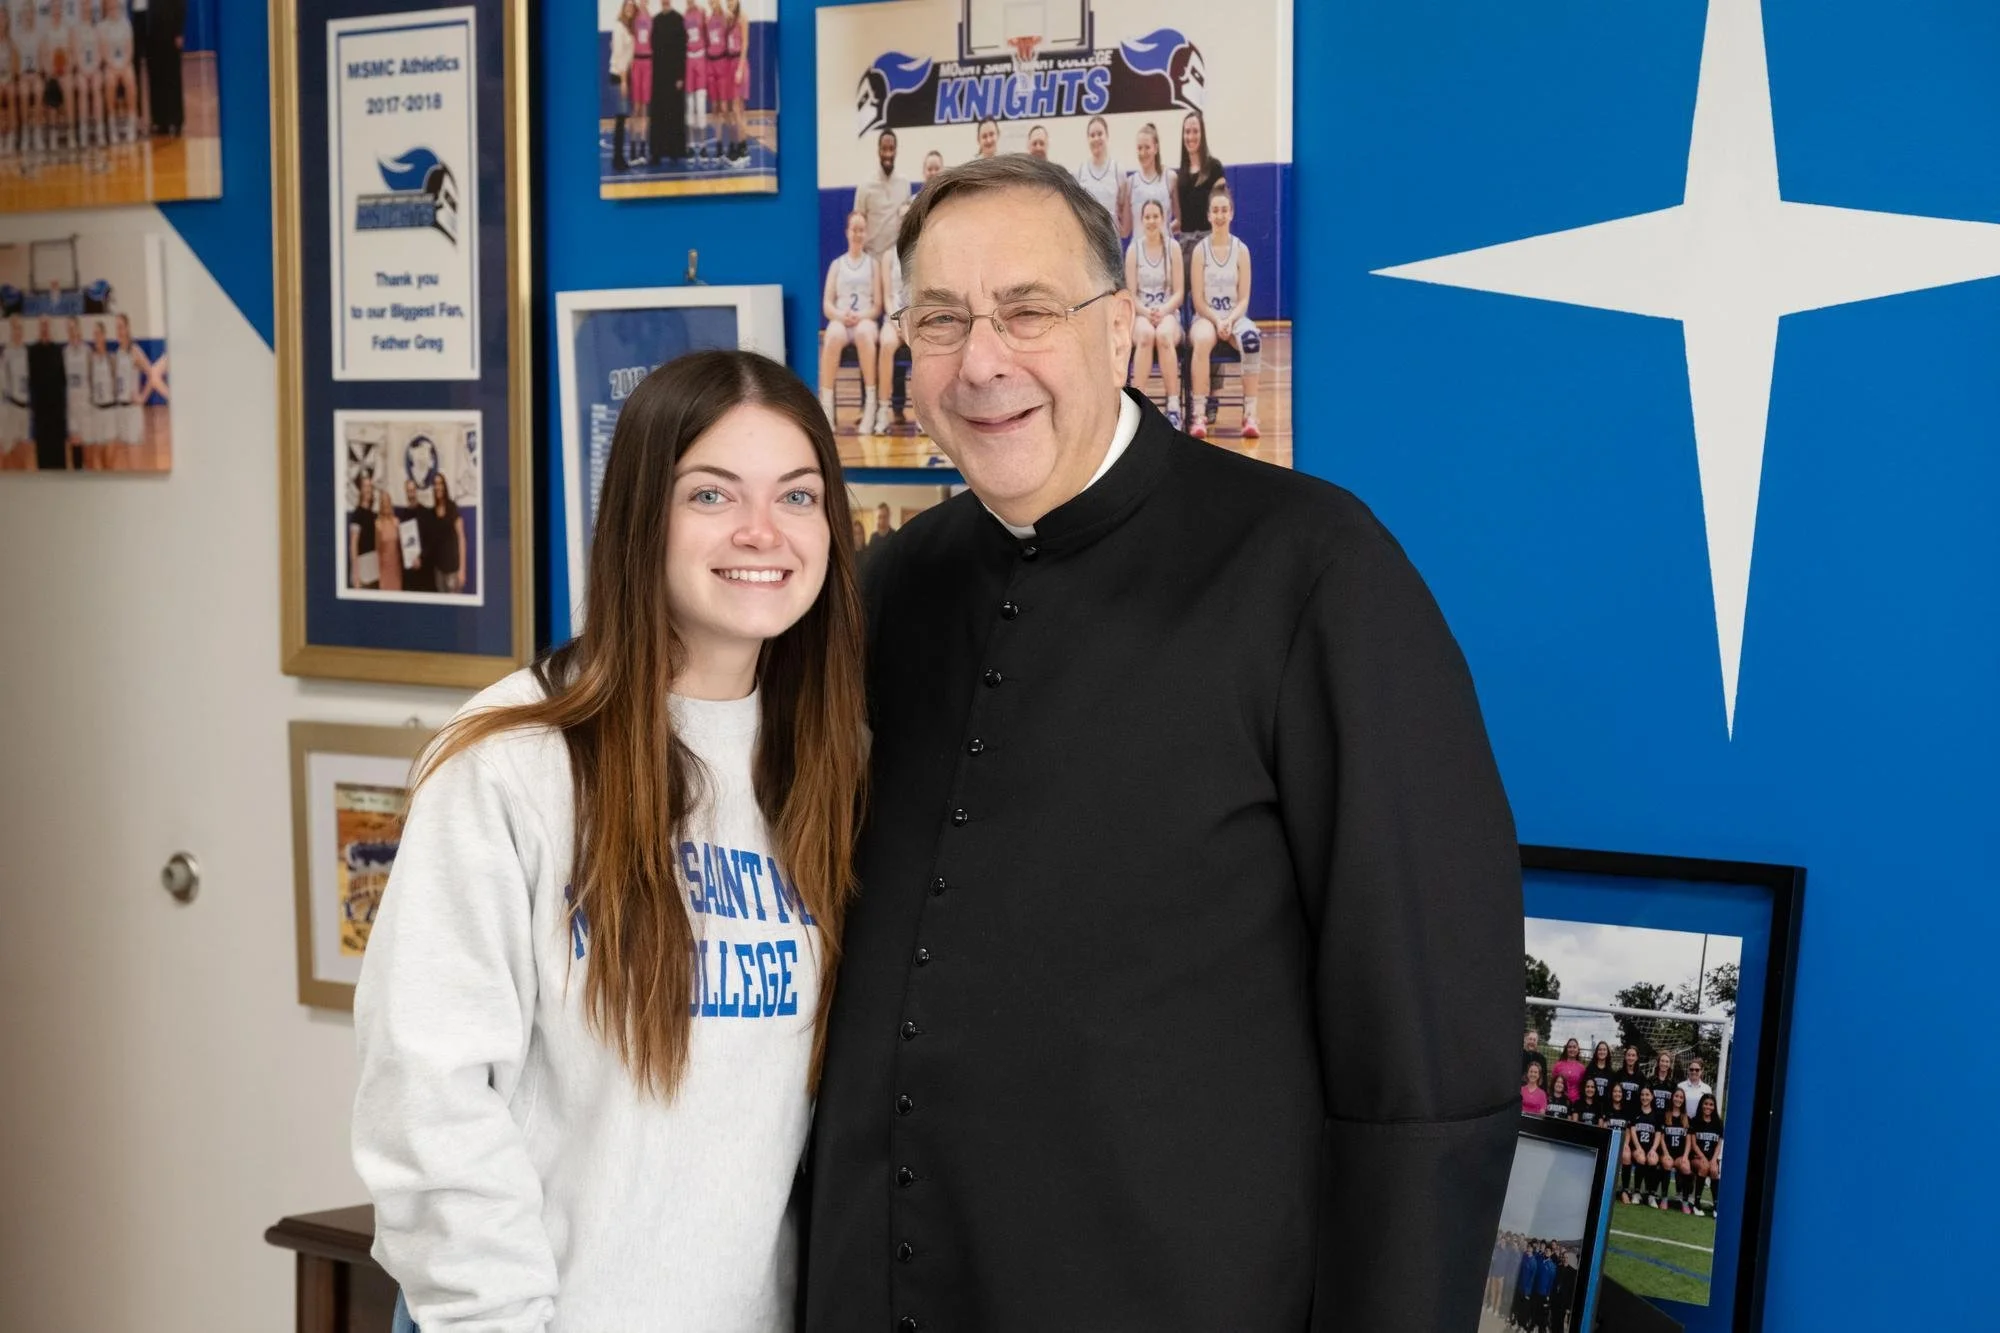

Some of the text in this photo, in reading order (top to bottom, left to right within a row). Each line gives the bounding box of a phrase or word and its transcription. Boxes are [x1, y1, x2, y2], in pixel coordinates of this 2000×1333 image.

[347, 56, 460, 79] MSMC Athletics
[366, 93, 442, 115] 2017-2018
[934, 66, 1111, 124] KNIGHTS
[375, 271, 439, 290] Thank you
[350, 304, 362, 319] to
[367, 307, 387, 319] our
[390, 302, 435, 322] Biggest
[372, 334, 444, 354] Father Greg
[678, 841, 767, 921] SAINT
[689, 939, 798, 1018] LLEGE
[1671, 1136, 1680, 1147] 15
